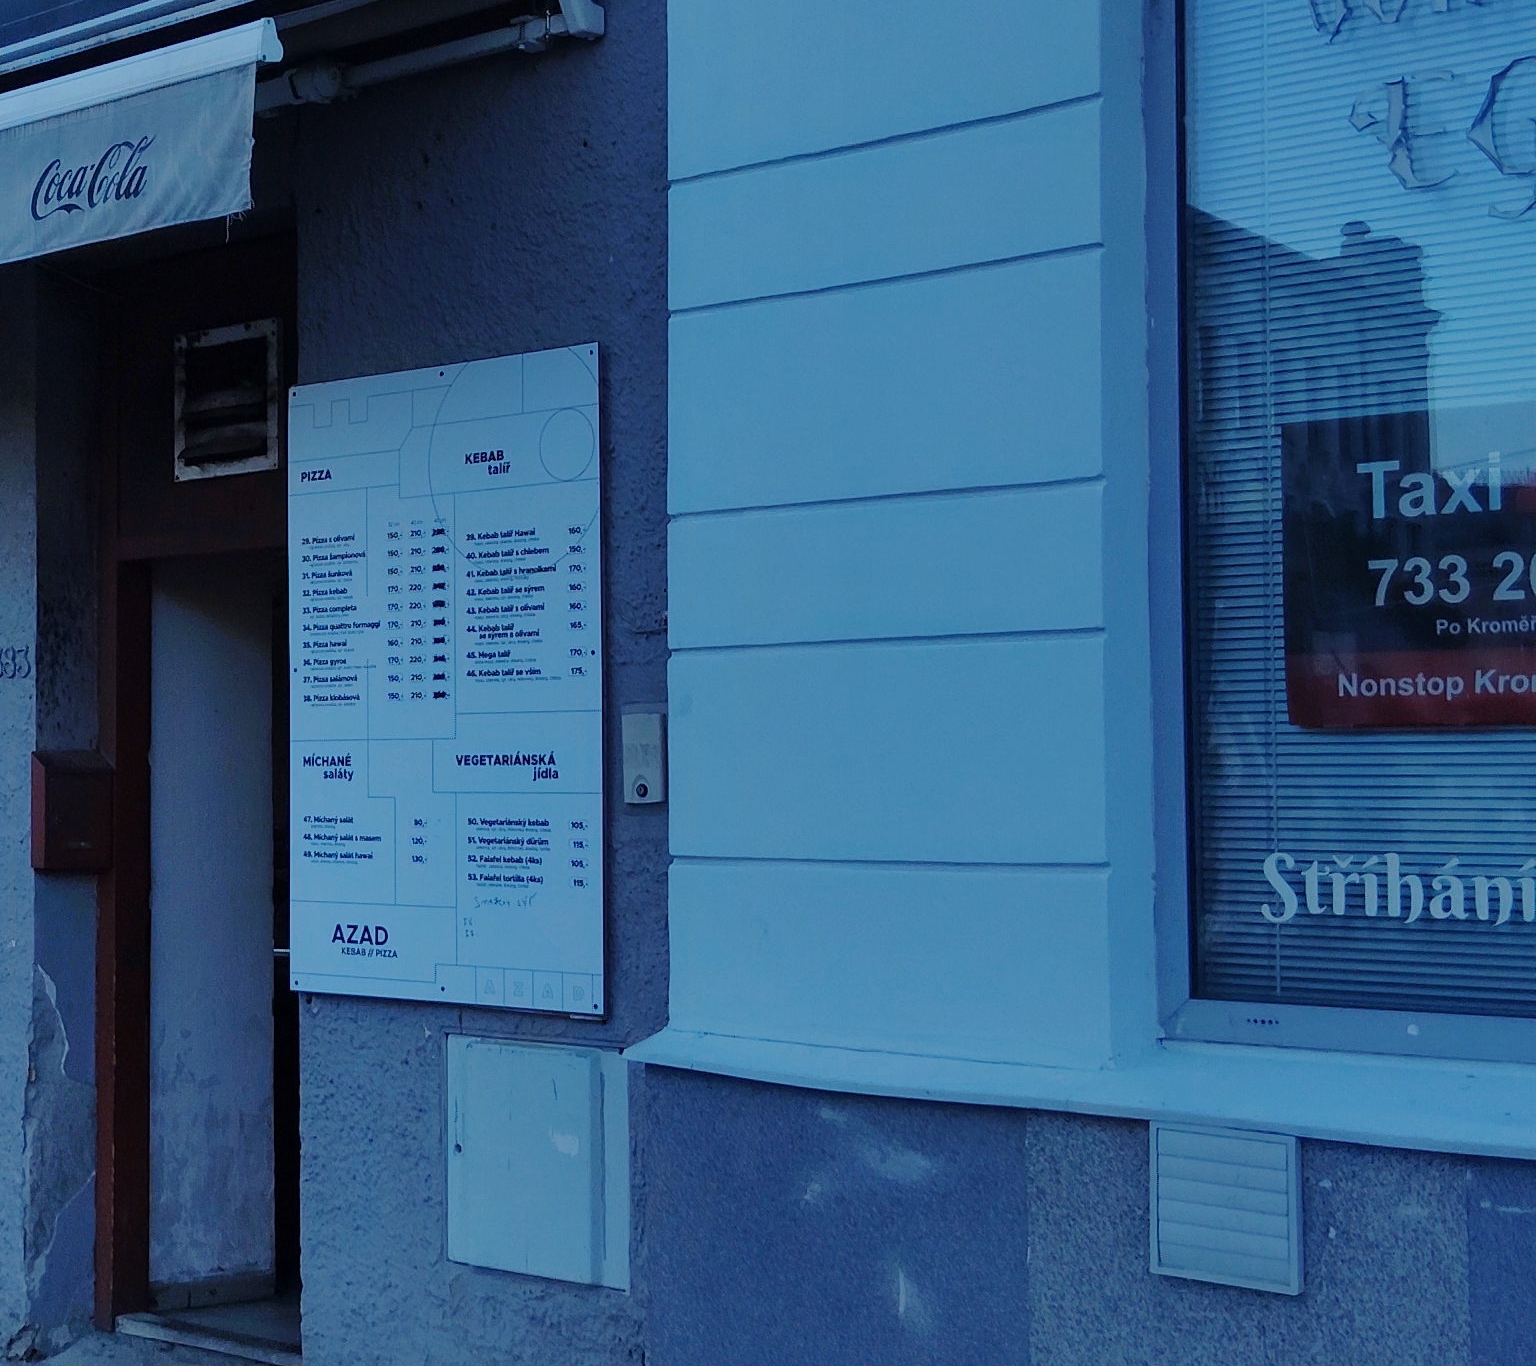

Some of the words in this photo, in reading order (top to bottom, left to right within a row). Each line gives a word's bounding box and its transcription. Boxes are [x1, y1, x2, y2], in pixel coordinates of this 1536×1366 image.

[31, 135, 156, 221] Coca-Cola
[464, 450, 504, 465] KEBAB
[301, 469, 332, 482] PIZZA
[487, 462, 511, 475] talíř
[1356, 451, 1502, 519] Taxi
[478, 532, 498, 540] Kebab
[478, 550, 499, 558] Kebab
[477, 568, 498, 576] Kebab
[1368, 554, 1470, 607] 733
[1492, 551, 1536, 601] 2
[478, 587, 499, 595] Kebab
[478, 606, 499, 614] Kebab
[1436, 618, 1461, 635] Po
[479, 669, 500, 677] Kebab
[1338, 672, 1464, 701] Nonstop
[1475, 669, 1536, 695] Kro
[303, 753, 351, 767] MÍCHANÉ
[456, 751, 556, 766] VEGETARIÁNSKÁ
[323, 769, 354, 781] saláty
[533, 766, 558, 781] jídla
[1261, 851, 1536, 927] Stříhání
[332, 923, 388, 946] AZAD
[341, 947, 366, 957] KEBAB
[376, 948, 398, 958] PIZZA
